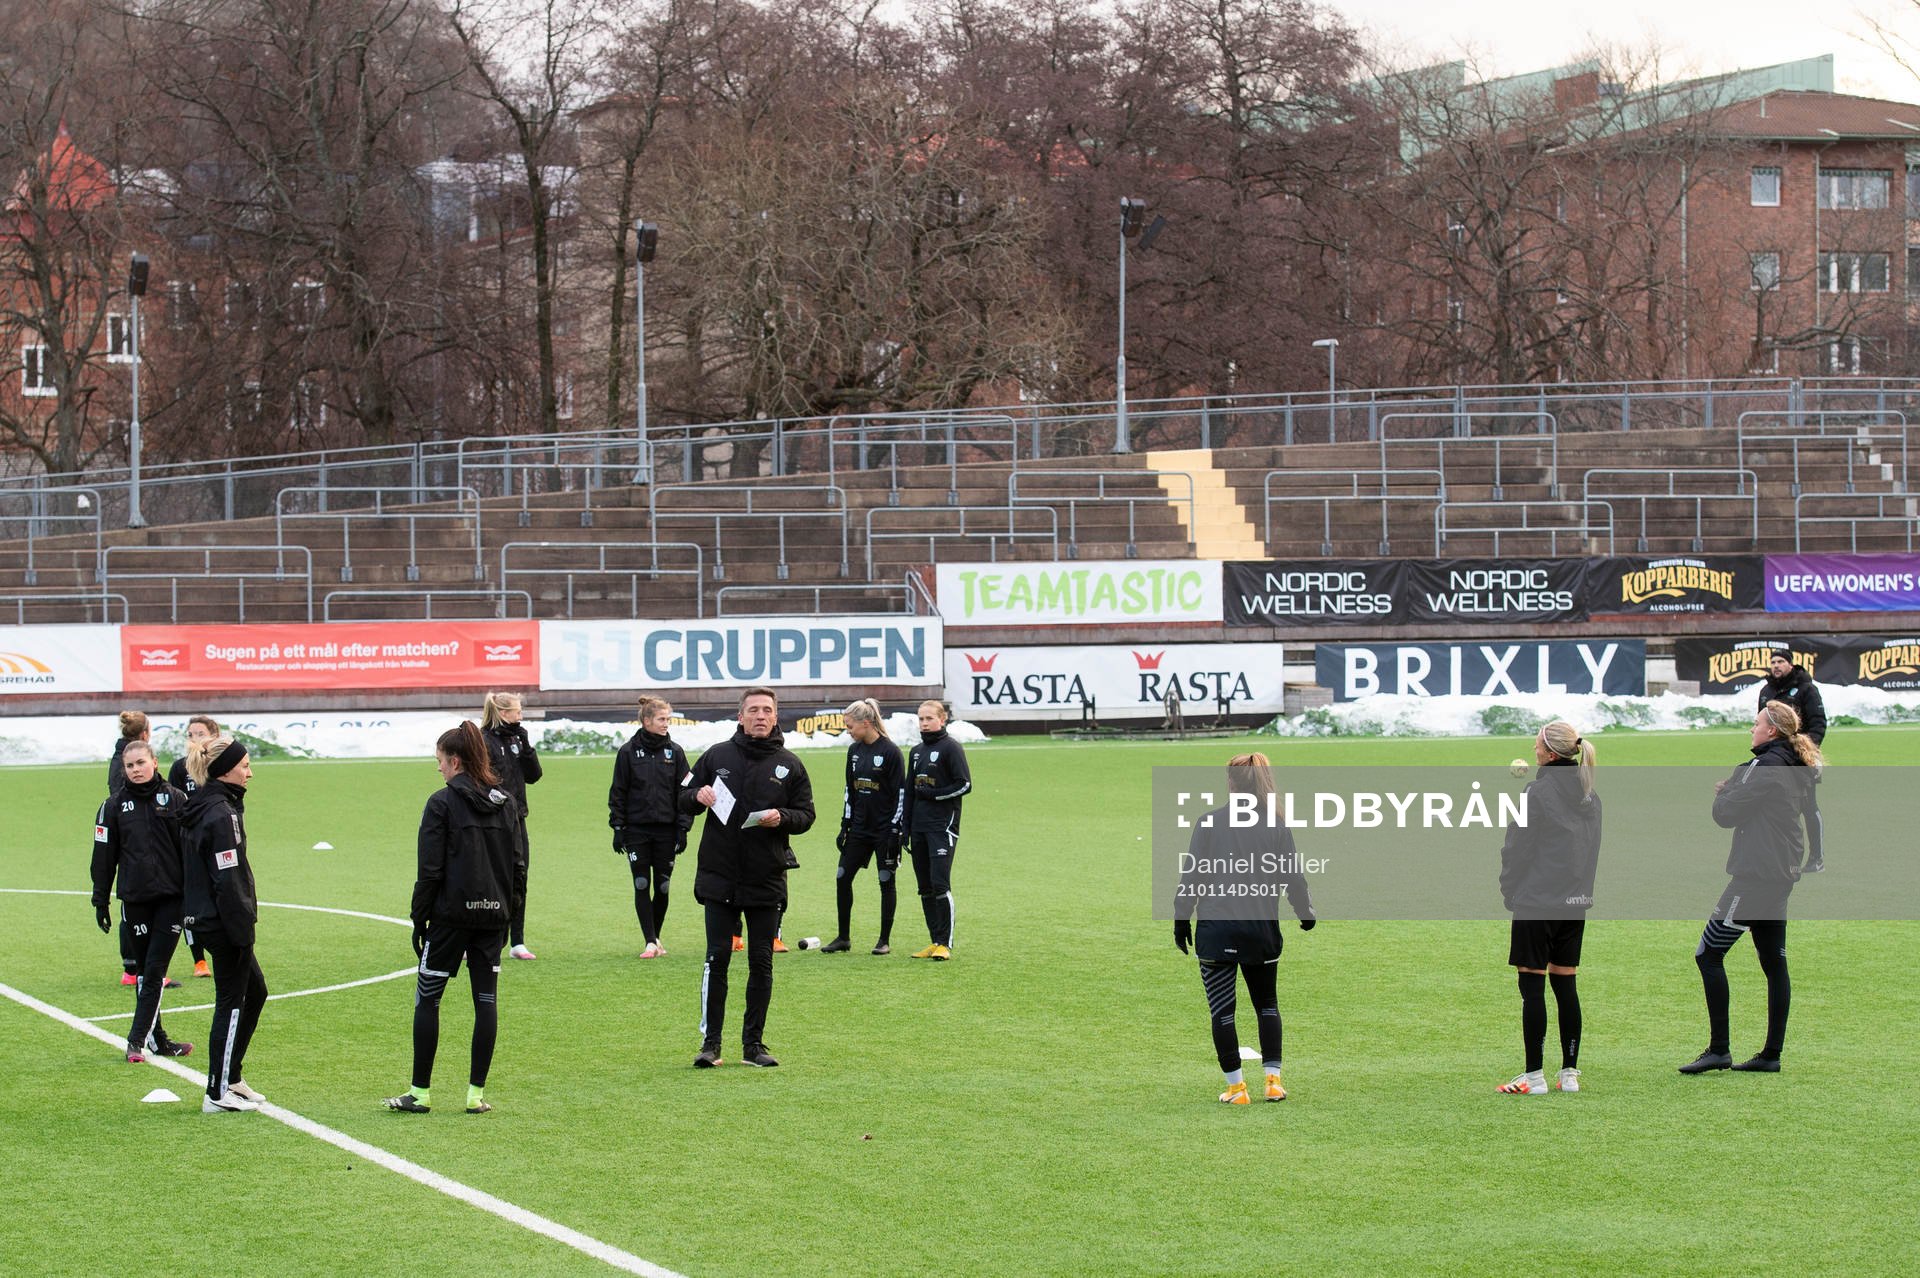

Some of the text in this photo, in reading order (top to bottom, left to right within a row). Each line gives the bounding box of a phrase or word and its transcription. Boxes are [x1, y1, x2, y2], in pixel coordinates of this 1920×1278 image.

[1265, 572, 1366, 592] NORDIC
[1450, 569, 1548, 591] NORDIC
[1621, 566, 1733, 604] KOPPARBERG
[1774, 573, 1914, 592] UEFA WOMEN'S
[959, 568, 1202, 618] TEAMTASTIC
[1426, 591, 1573, 612] WELLNESS
[1241, 594, 1392, 615] WELLNESS
[1650, 603, 1705, 611] ALCOHOL-FREE
[205, 641, 459, 661] Sugen på ett mål efter matchen?
[551, 627, 925, 682] JJ GRUPPEN
[1345, 644, 1619, 698] BRIXLY
[1708, 648, 1816, 684] KOPPARRG
[970, 674, 1088, 705] RASTA
[1138, 671, 1255, 702] RASTA
[186, 781, 196, 791] 12
[121, 800, 135, 813] 20
[629, 852, 637, 862] 16
[466, 899, 500, 910] umbro
[133, 923, 148, 936] 20
